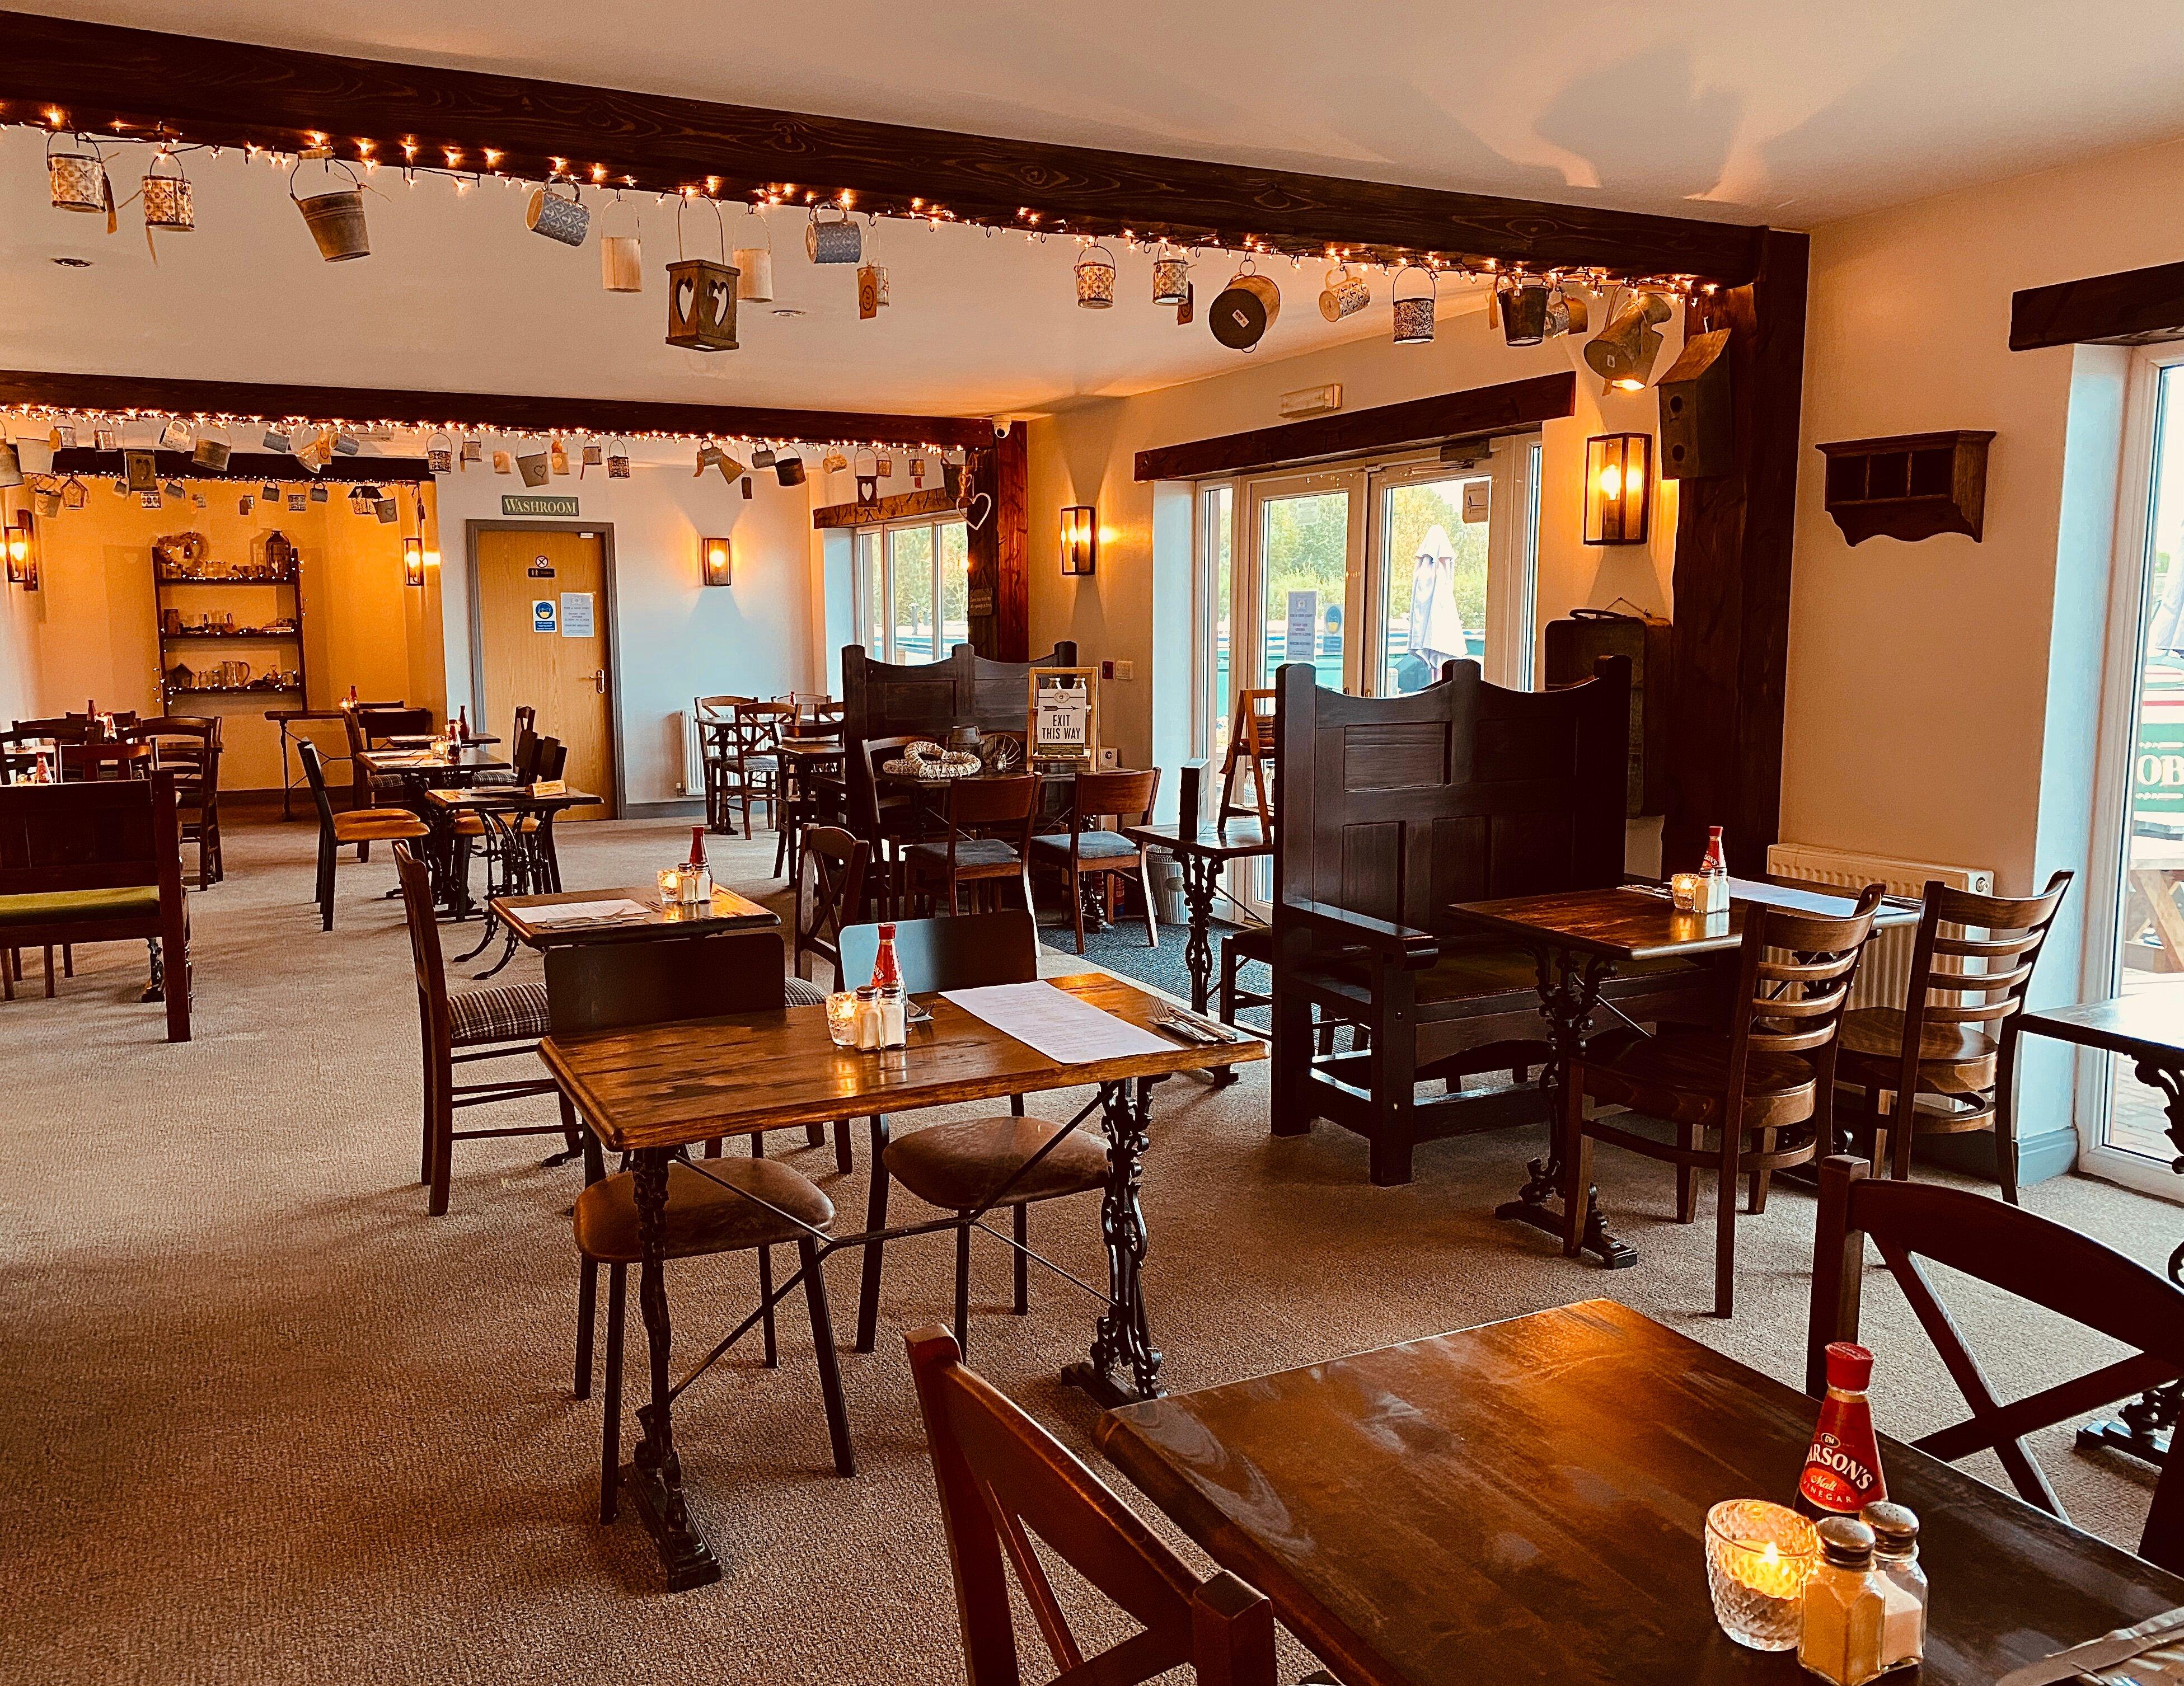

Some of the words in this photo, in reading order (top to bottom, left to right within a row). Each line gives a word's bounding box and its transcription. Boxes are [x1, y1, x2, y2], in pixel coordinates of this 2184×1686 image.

[504, 498, 577, 514] WASHROOM
[1053, 715, 1070, 726] EXIT
[1042, 727, 1061, 739] THIS
[1064, 727, 1081, 739] WAY
[1807, 1444, 1873, 1489] ARSON'S
